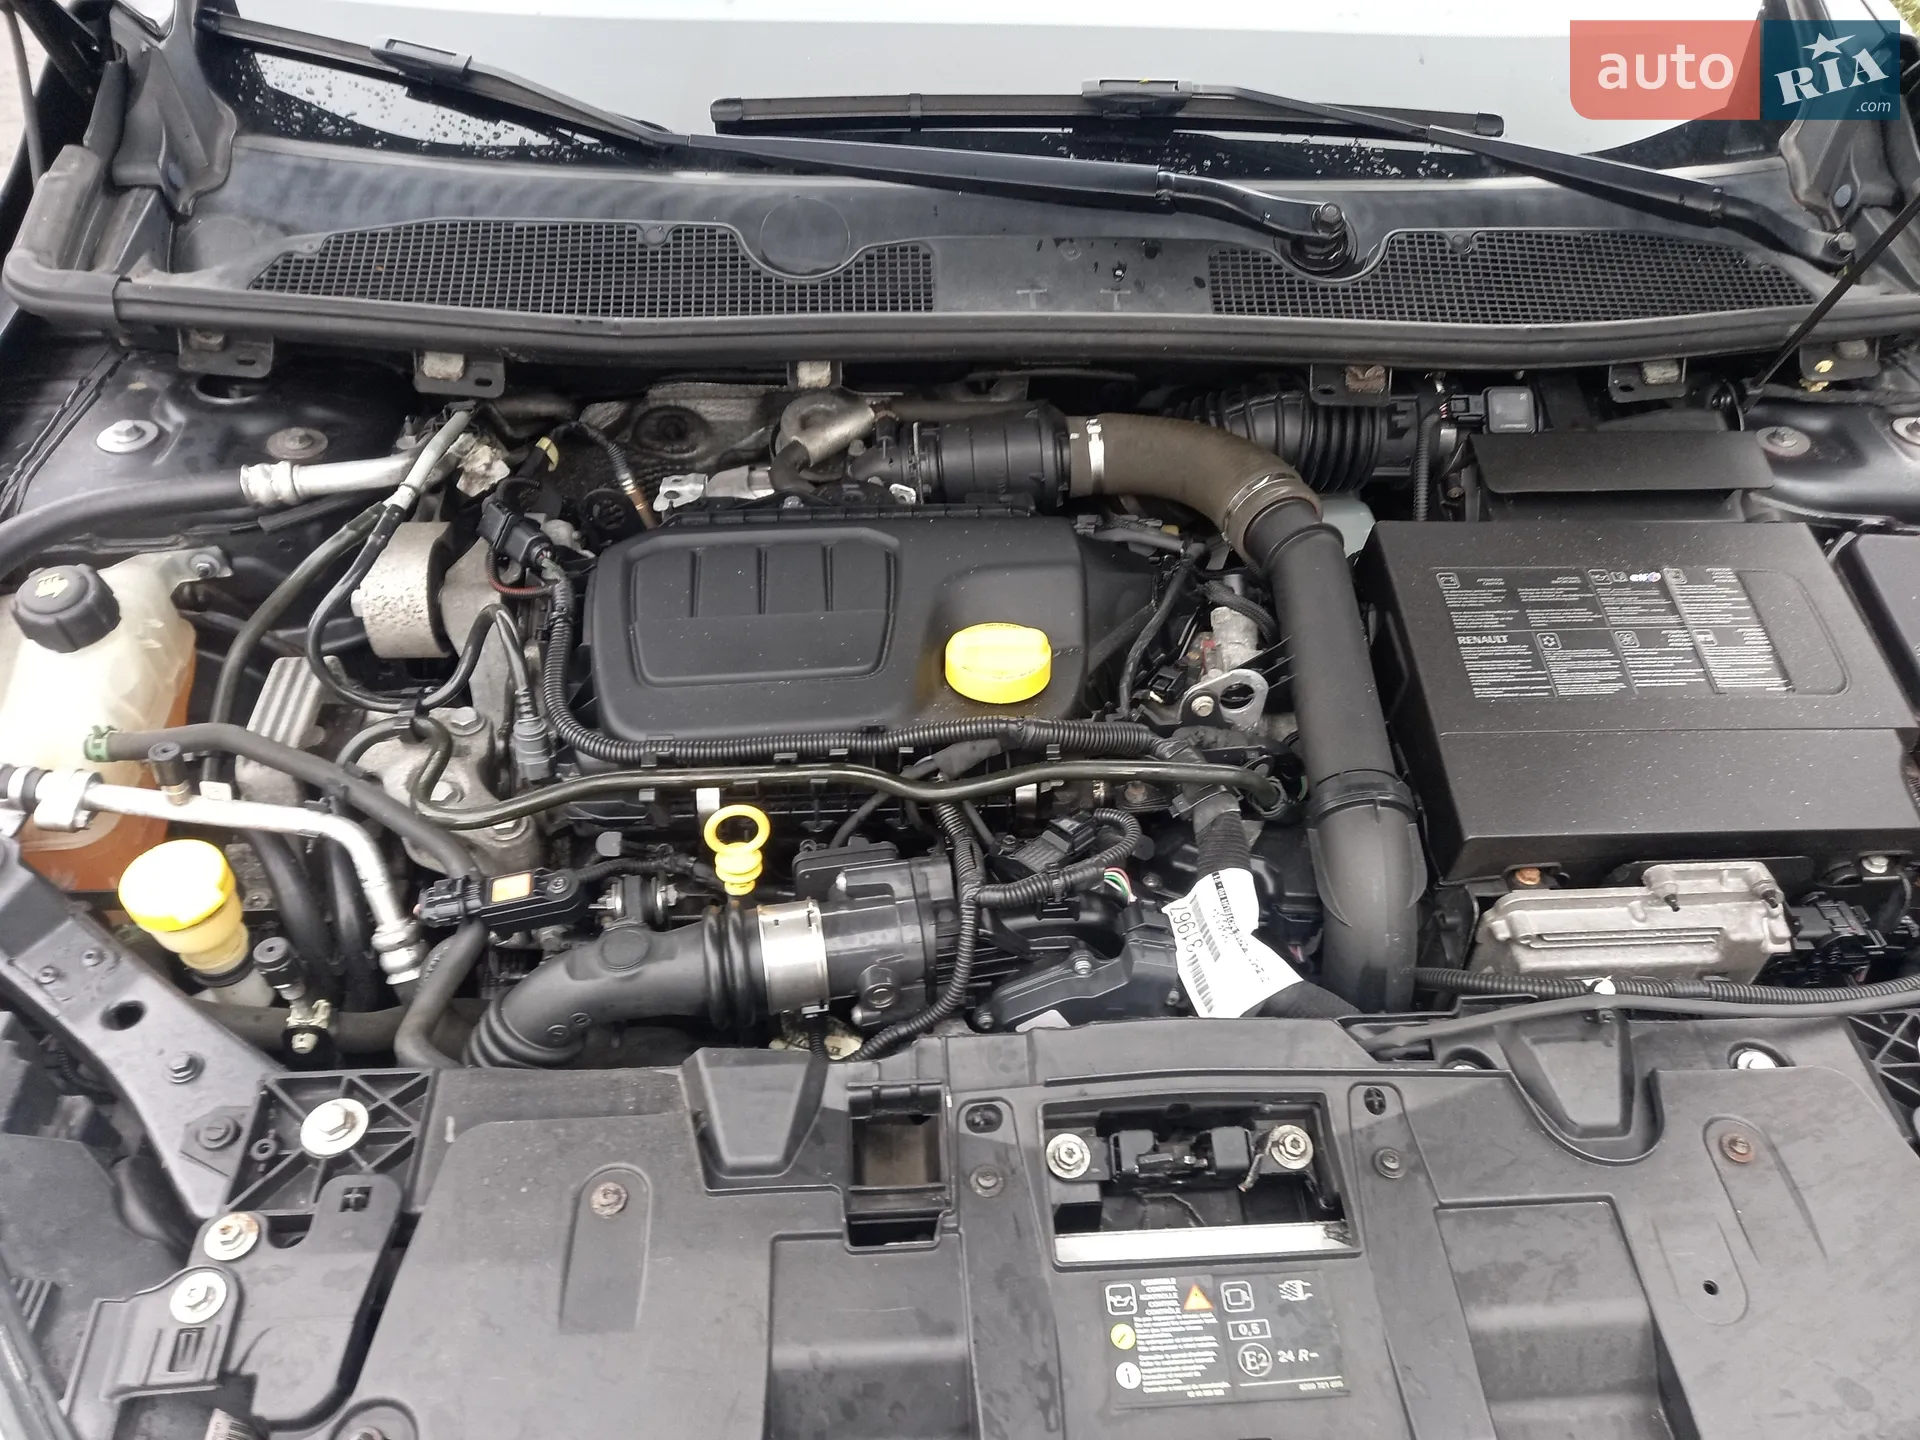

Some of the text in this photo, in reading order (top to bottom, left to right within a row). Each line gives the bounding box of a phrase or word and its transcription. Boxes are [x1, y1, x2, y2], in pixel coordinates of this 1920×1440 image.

[1456, 634, 1509, 645] RENAULT
[1169, 906, 1203, 953] 31967
[1238, 1322, 1261, 1337] 0,5
[1277, 1349, 1295, 1363] 24
